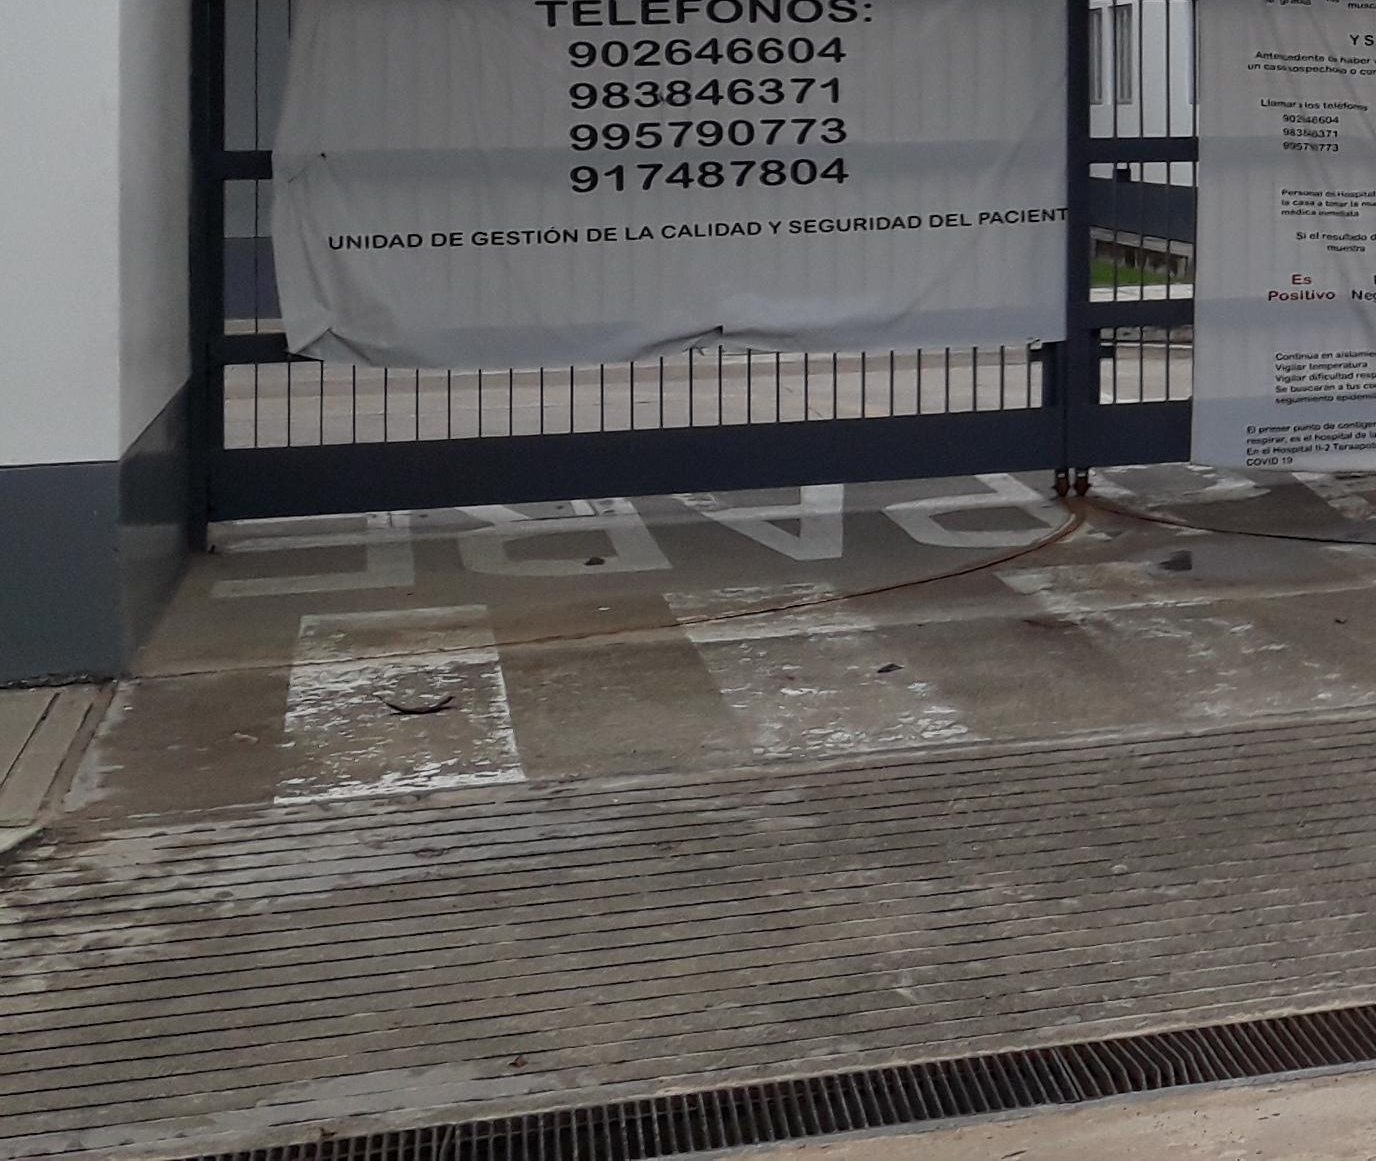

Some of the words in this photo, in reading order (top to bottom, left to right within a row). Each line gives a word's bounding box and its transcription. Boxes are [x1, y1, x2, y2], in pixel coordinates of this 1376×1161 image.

[569, 37, 846, 68] 902646604
[1350, 35, 1359, 45] Y
[570, 78, 846, 109] 983846371
[570, 118, 846, 151] 995790773
[570, 158, 849, 192] 917487804
[329, 234, 422, 250] UNIDAD
[432, 233, 463, 247] DE
[472, 227, 577, 245] GESTIÓN
[587, 228, 617, 242] DE
[626, 226, 654, 240] LA
[662, 222, 761, 239] CALIDAD
[769, 221, 781, 234] Y
[789, 216, 921, 233] SEGURIDAD
[930, 214, 972, 227] DEL
[1292, 274, 1311, 285] Es
[1268, 290, 1335, 301] Positivo
